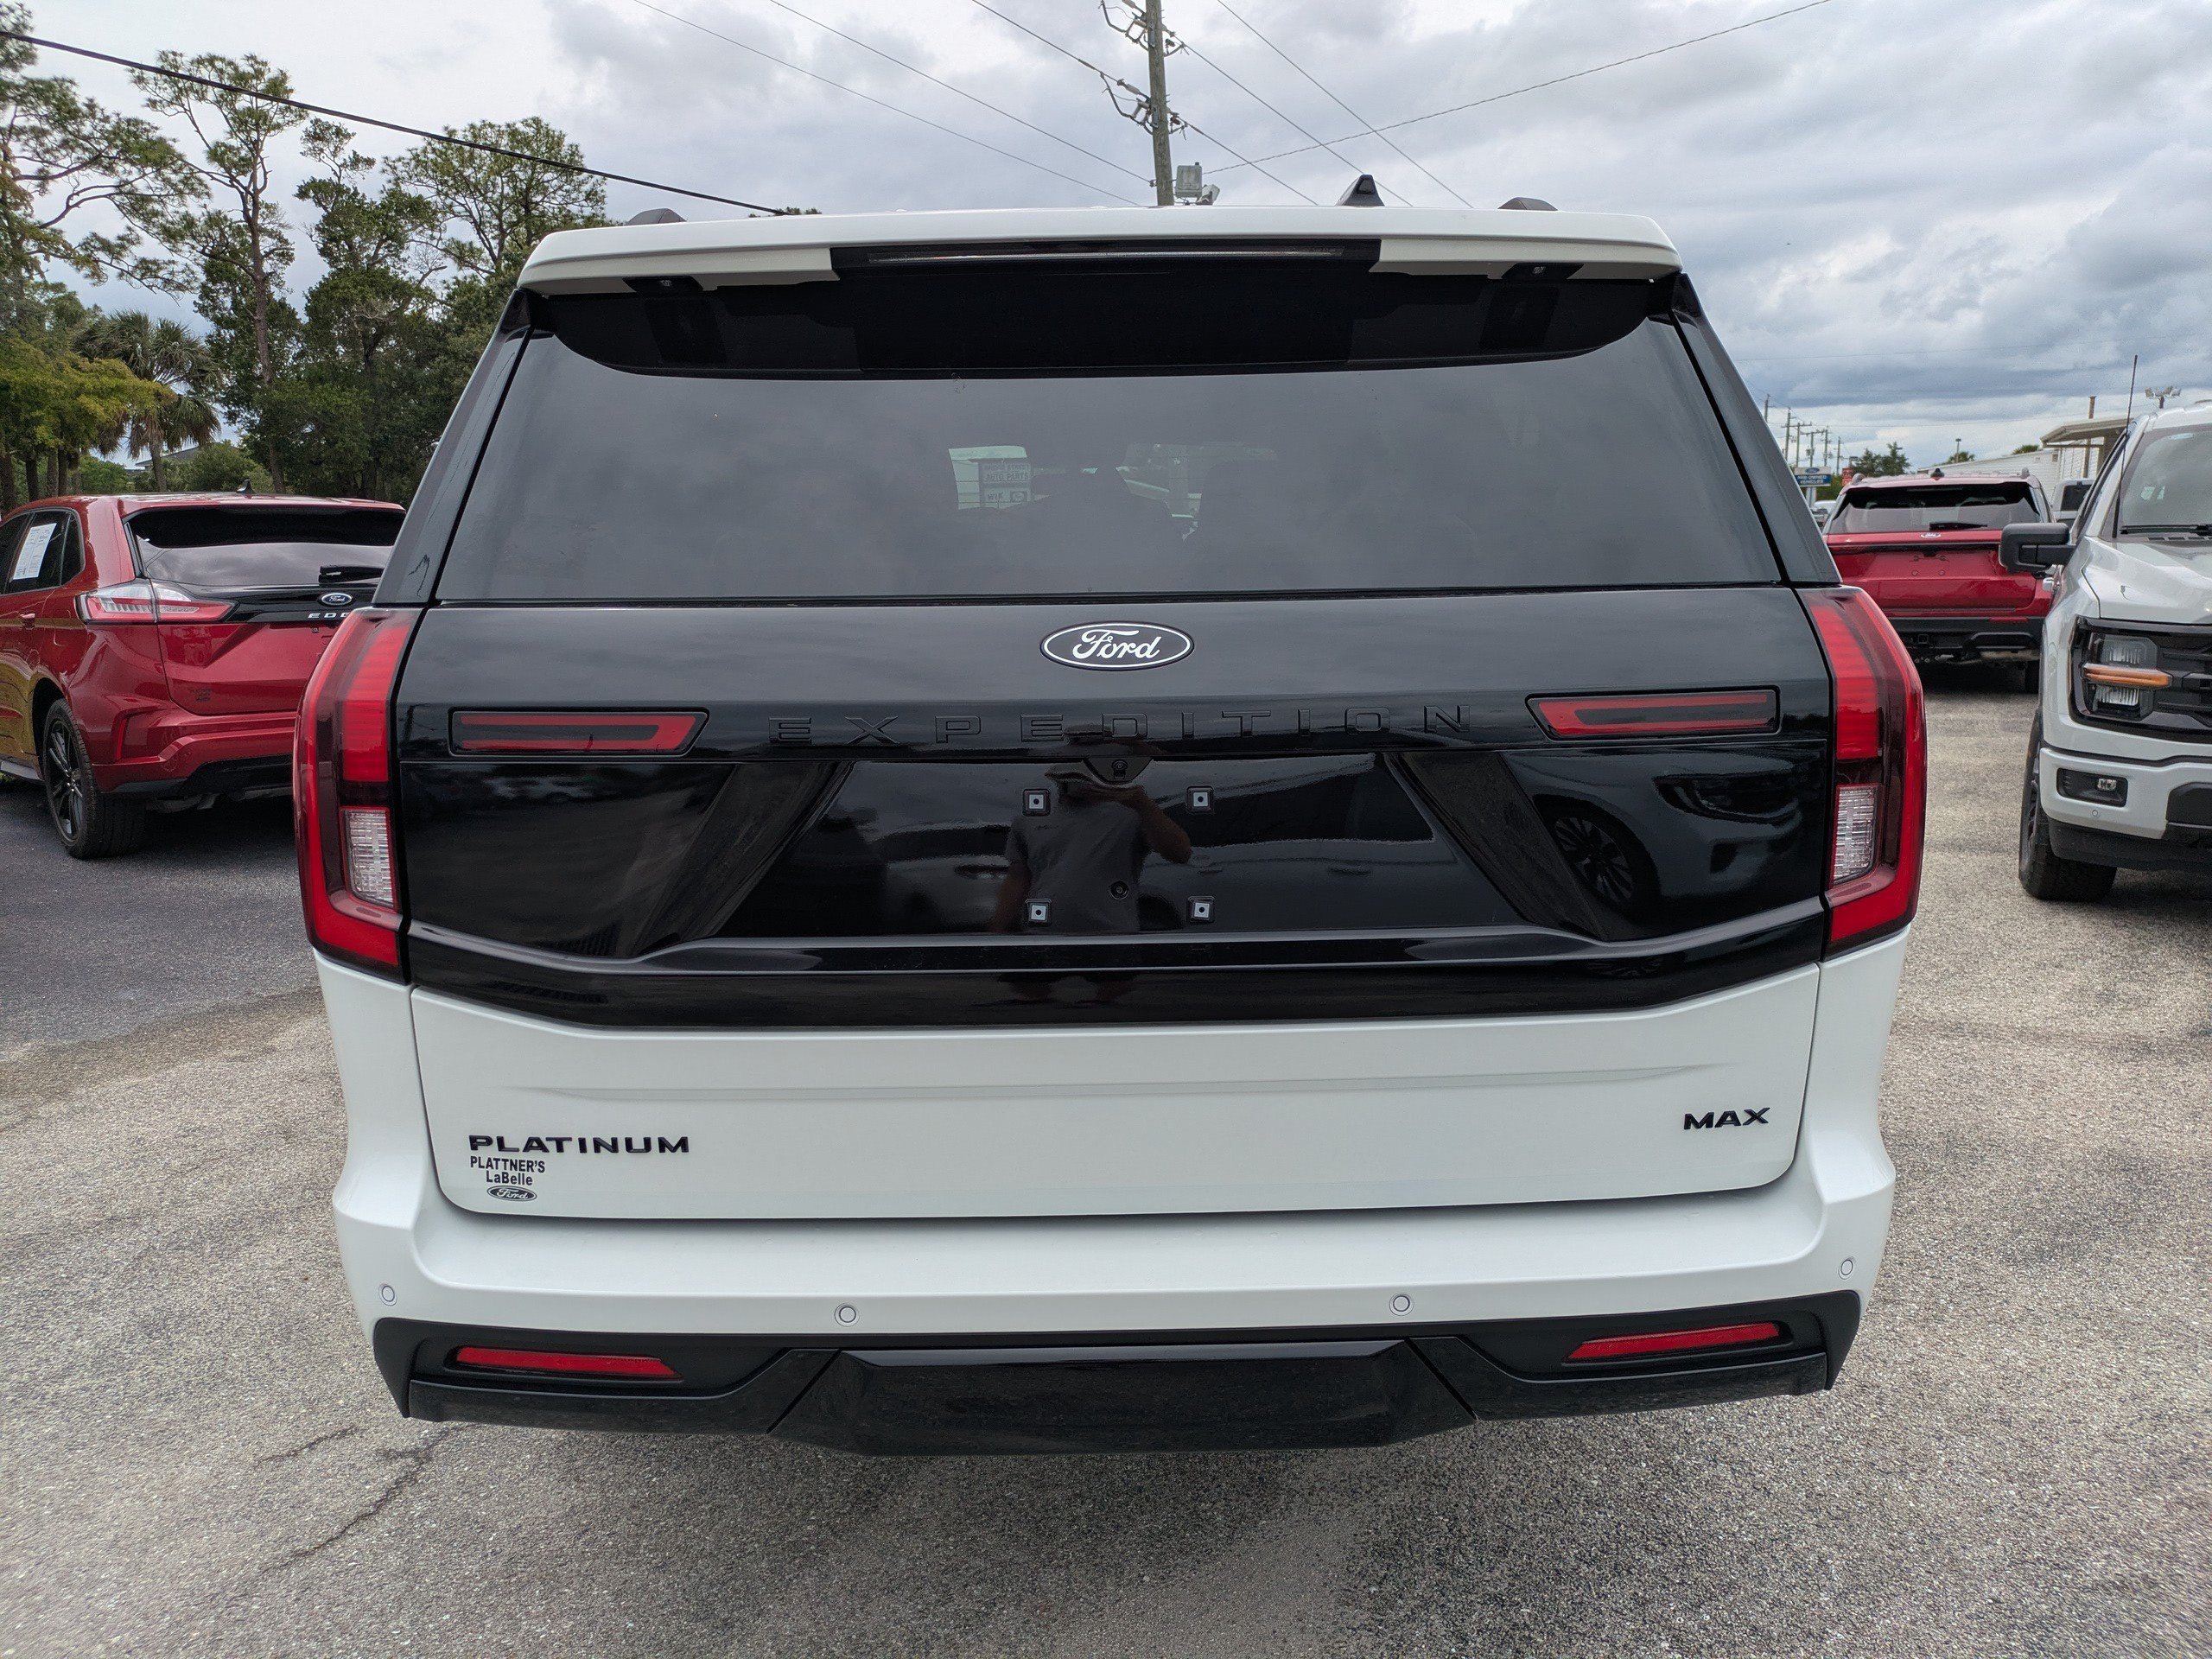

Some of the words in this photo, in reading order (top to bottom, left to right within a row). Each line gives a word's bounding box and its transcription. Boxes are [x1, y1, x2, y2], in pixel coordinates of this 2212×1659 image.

[1072, 629, 1162, 659] Ford
[767, 704, 1471, 745] EXPEDITION
[1683, 1107, 1770, 1130] MAX
[468, 1135, 690, 1154] PLATINUM
[470, 1155, 546, 1173] PLATTNER'S
[486, 1170, 533, 1186] LaBelle
[496, 1187, 529, 1200] Ford
